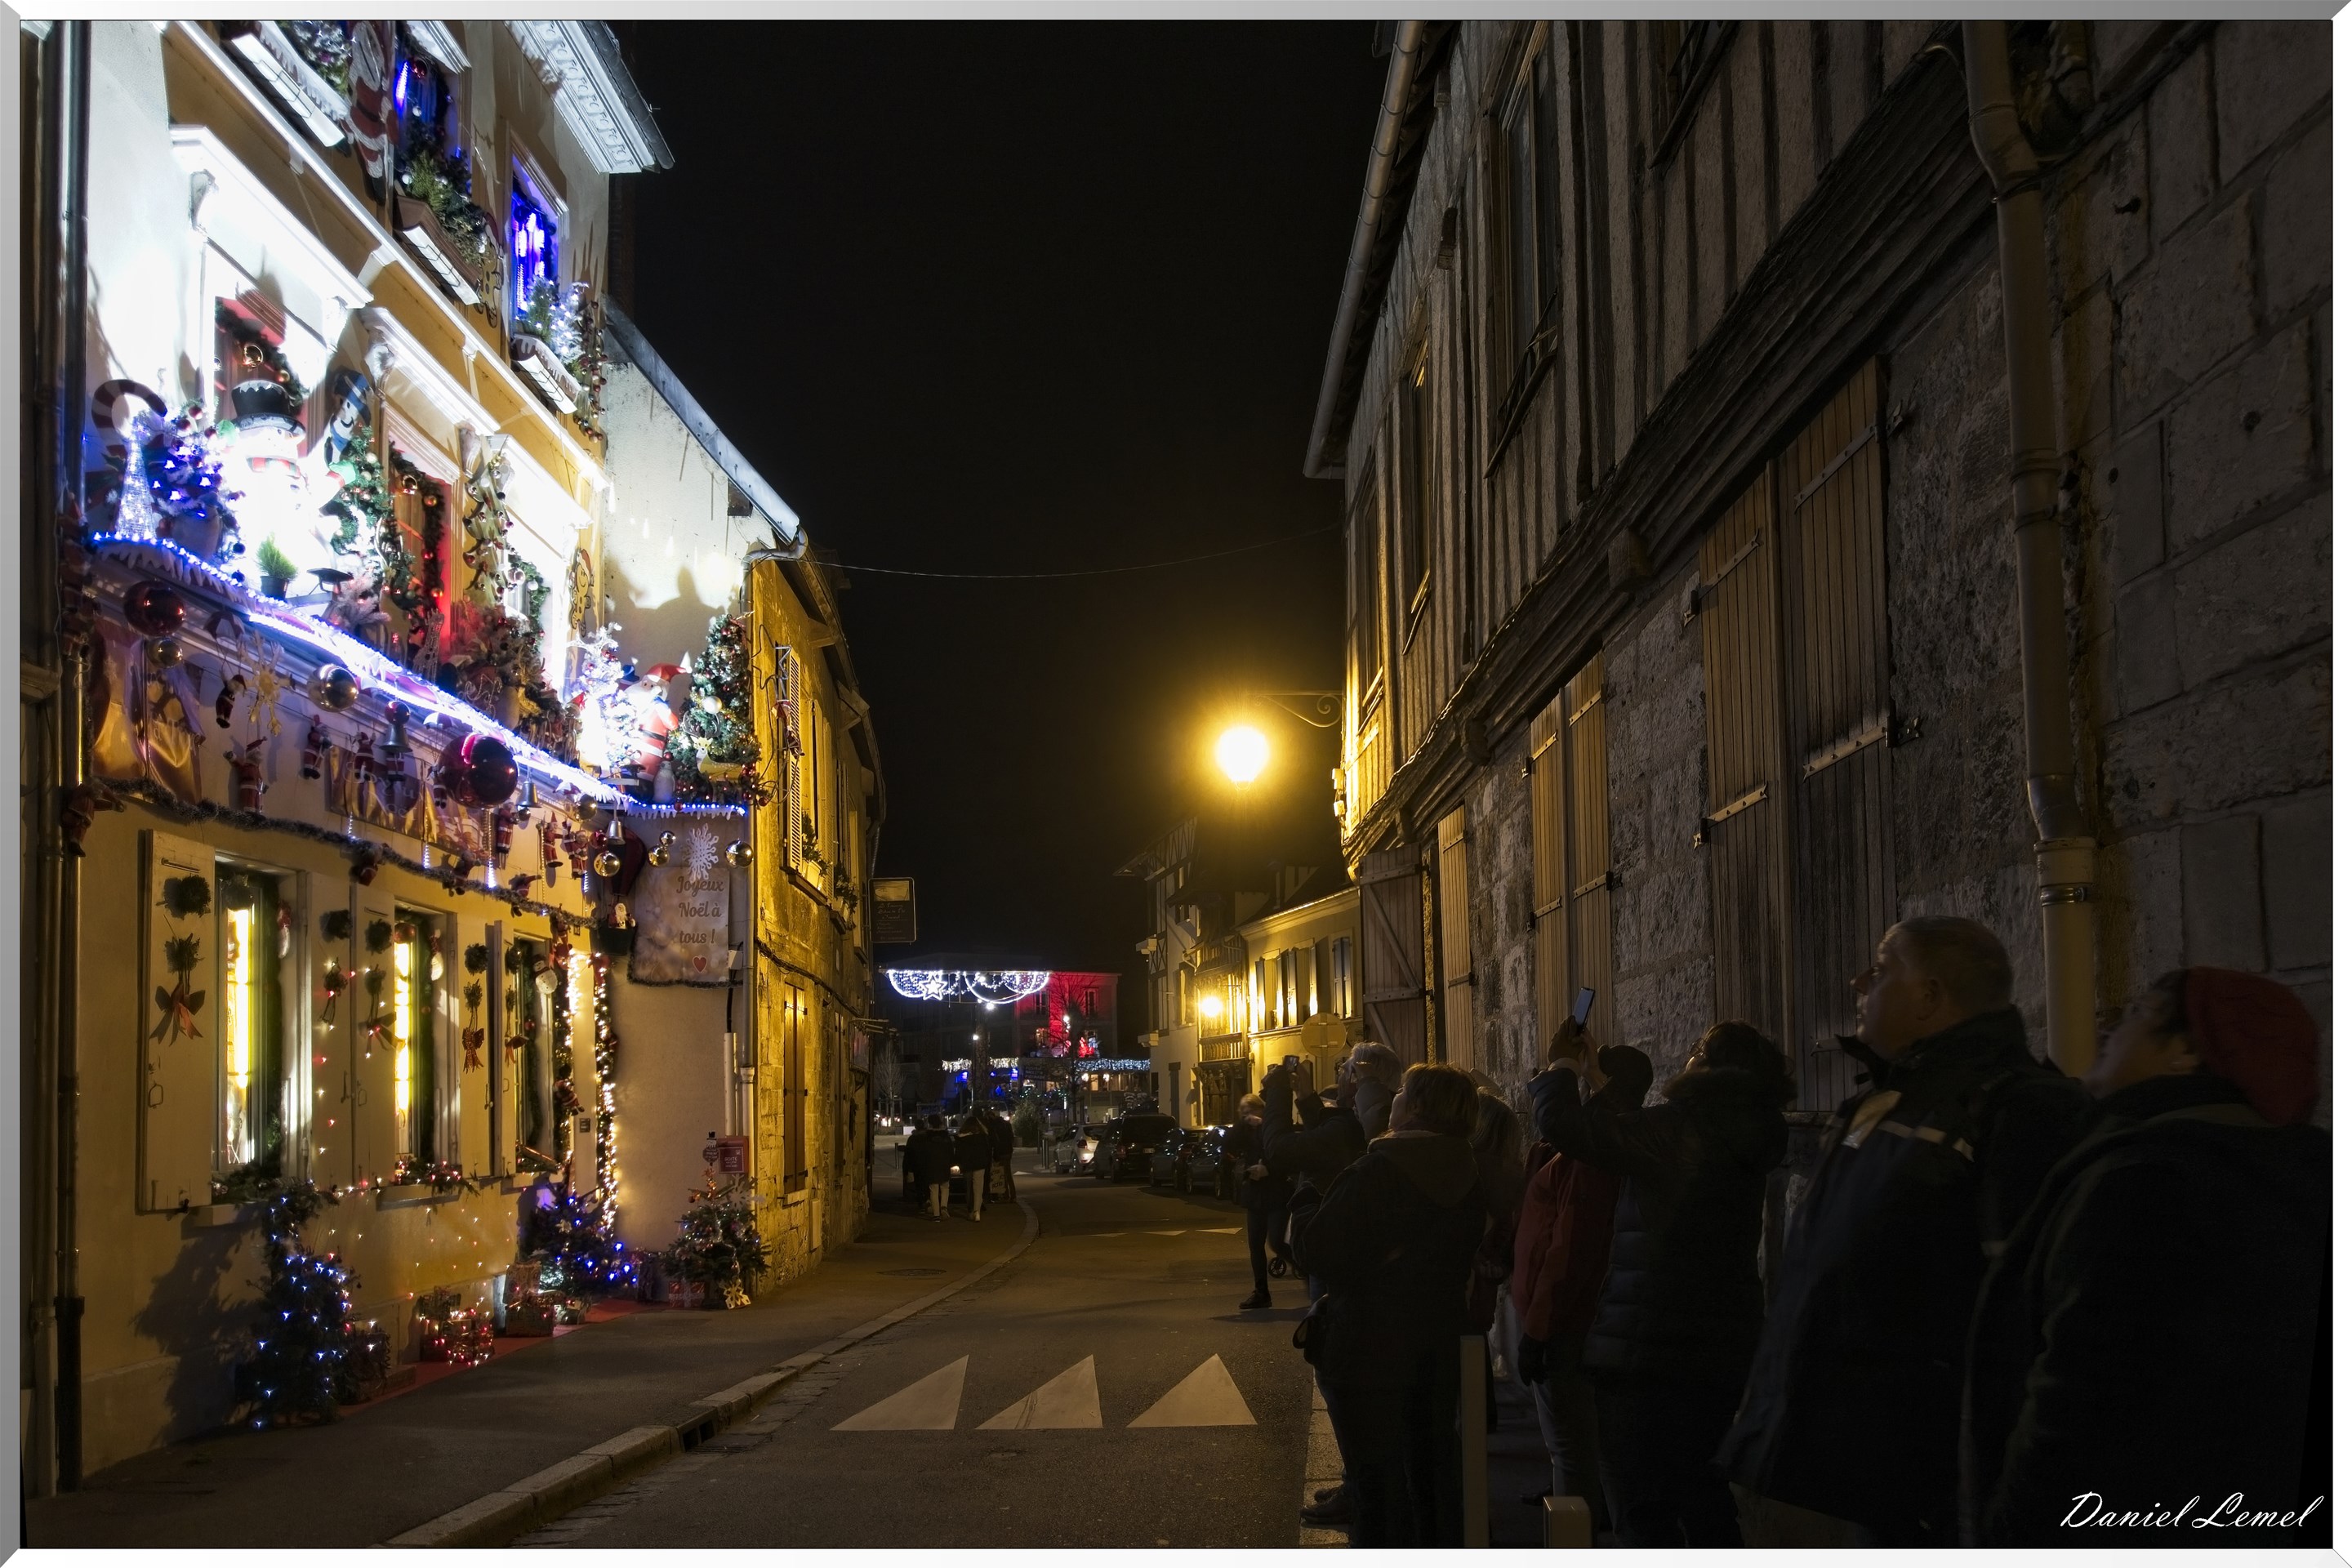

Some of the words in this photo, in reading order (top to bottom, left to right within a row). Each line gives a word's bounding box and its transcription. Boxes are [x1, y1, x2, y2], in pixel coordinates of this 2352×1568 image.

[676, 875, 724, 897] Joyeux
[679, 901, 710, 918] Noël
[711, 902, 721, 918] à
[679, 930, 706, 943] tous
[710, 929, 715, 943] !
